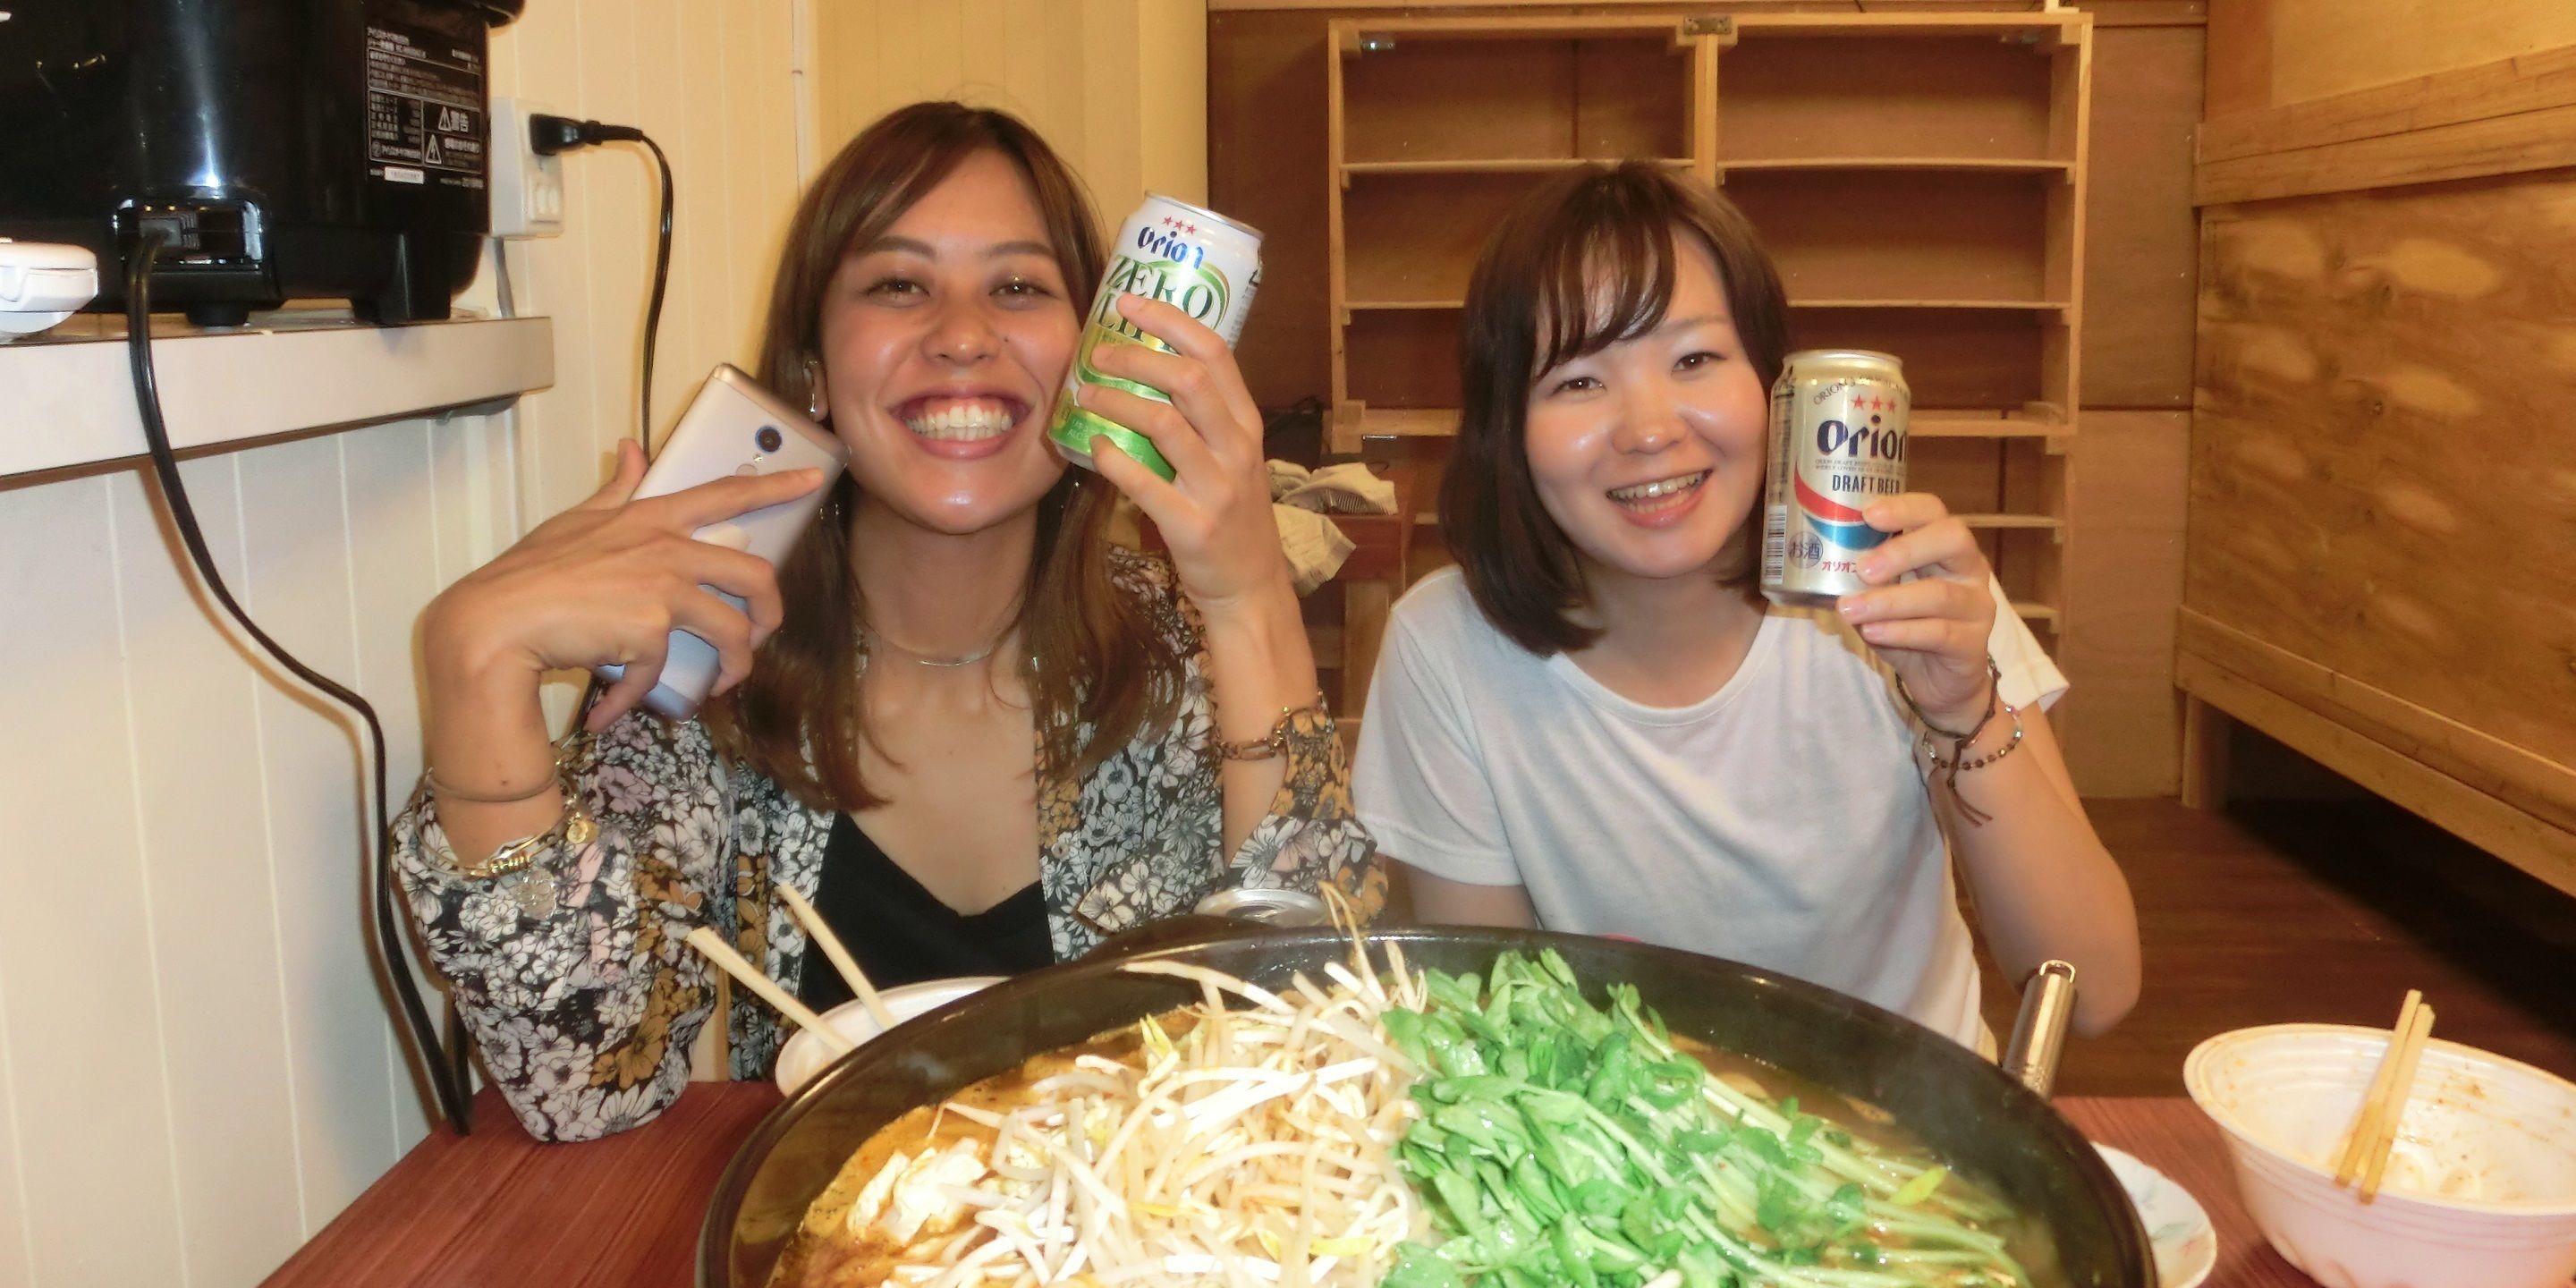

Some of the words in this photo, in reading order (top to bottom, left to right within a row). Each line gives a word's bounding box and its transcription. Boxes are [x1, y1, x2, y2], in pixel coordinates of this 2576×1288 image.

[1138, 226, 1204, 269] Orion
[1106, 254, 1214, 319] ZERO
[1833, 474, 1874, 493] DRAFT
[1877, 477, 1901, 495] BEER
[1788, 542, 1820, 560] お酒
